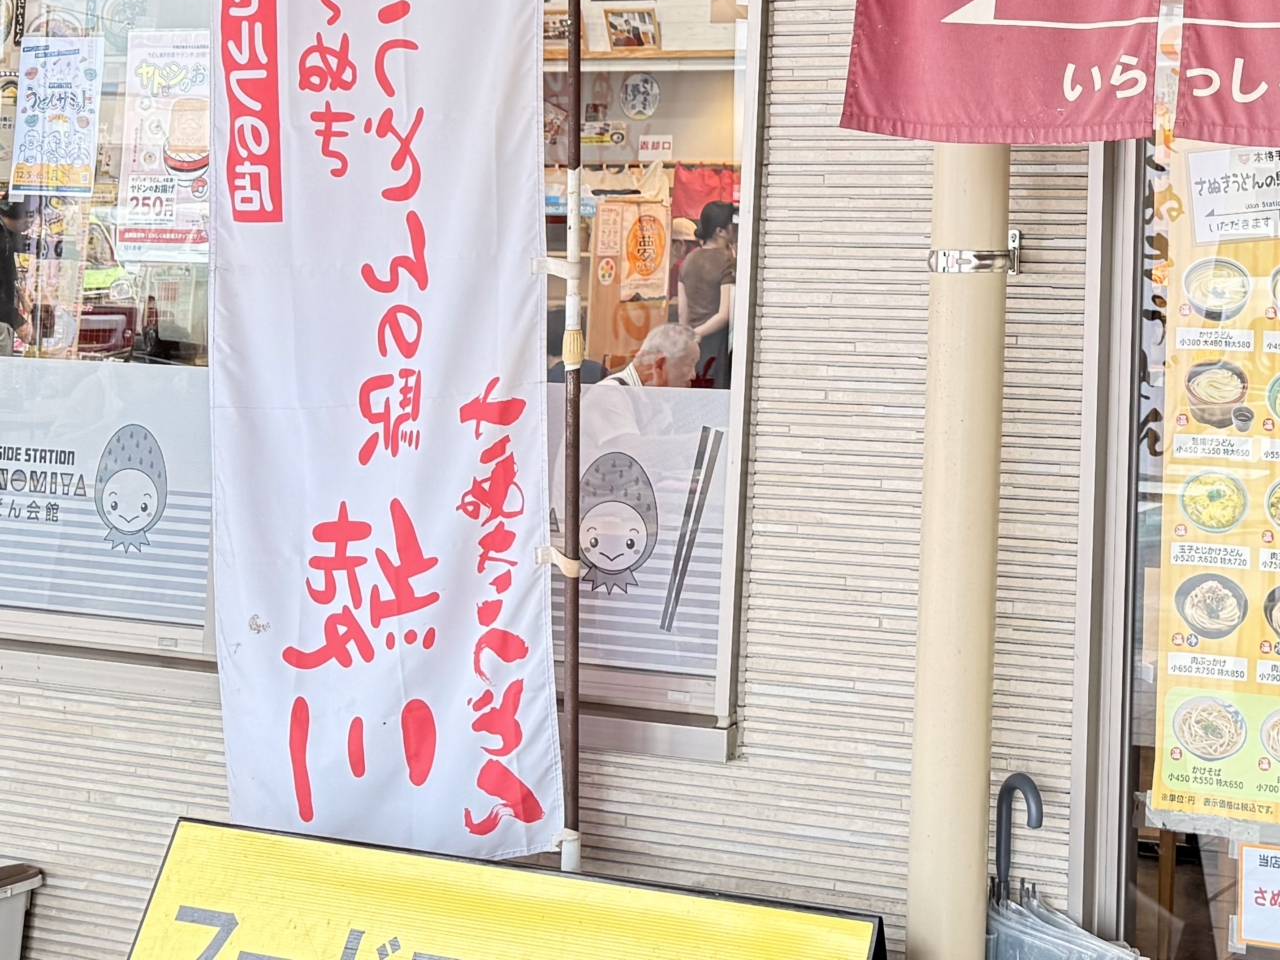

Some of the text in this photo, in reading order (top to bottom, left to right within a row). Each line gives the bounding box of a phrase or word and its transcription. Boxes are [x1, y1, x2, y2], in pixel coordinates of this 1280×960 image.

[640, 141, 671, 150] 返却口
[1209, 217, 1271, 232] いただきます
[1199, 331, 1233, 340] かけうどん
[25, 448, 75, 465] STATION
[0, 498, 59, 522] ん会館
[1179, 545, 1243, 557] 玉子とじかけうどん
[1173, 554, 1247, 566] 小520 大620 特大720
[1191, 656, 1226, 667] 肉ぶっかけ
[1259, 673, 1280, 682] 小790
[1192, 766, 1221, 777] かけそば
[1256, 783, 1279, 793] 小700
[1204, 798, 1273, 814] 表示価格は税込です。
